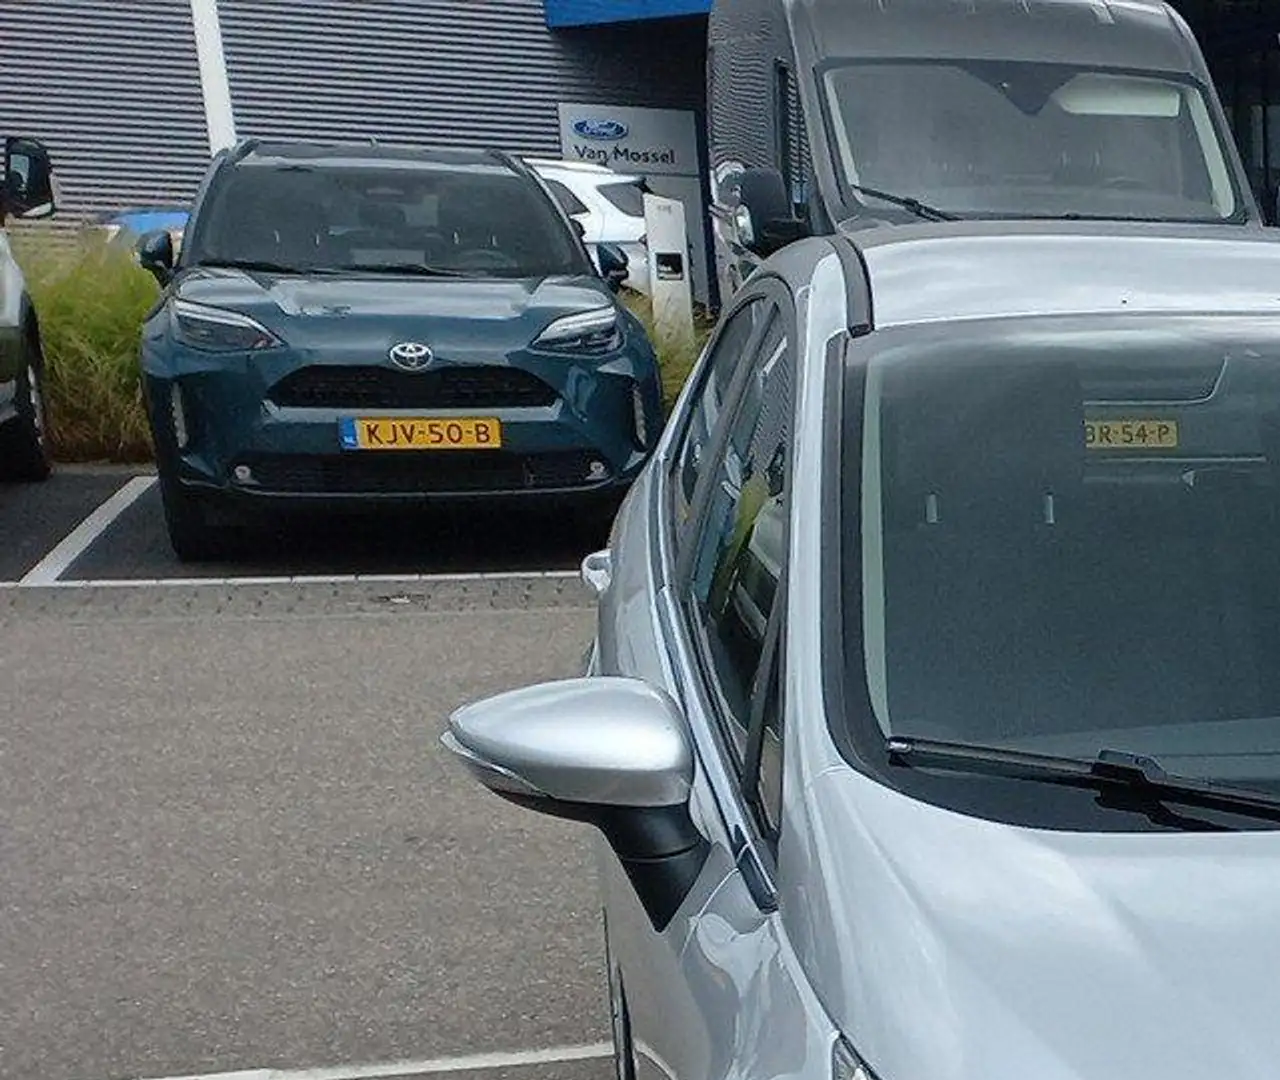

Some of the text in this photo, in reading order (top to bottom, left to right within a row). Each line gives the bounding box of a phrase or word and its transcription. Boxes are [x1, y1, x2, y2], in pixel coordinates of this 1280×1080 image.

[574, 145, 675, 165] Van Mossel
[367, 423, 490, 445] KJV-50-B
